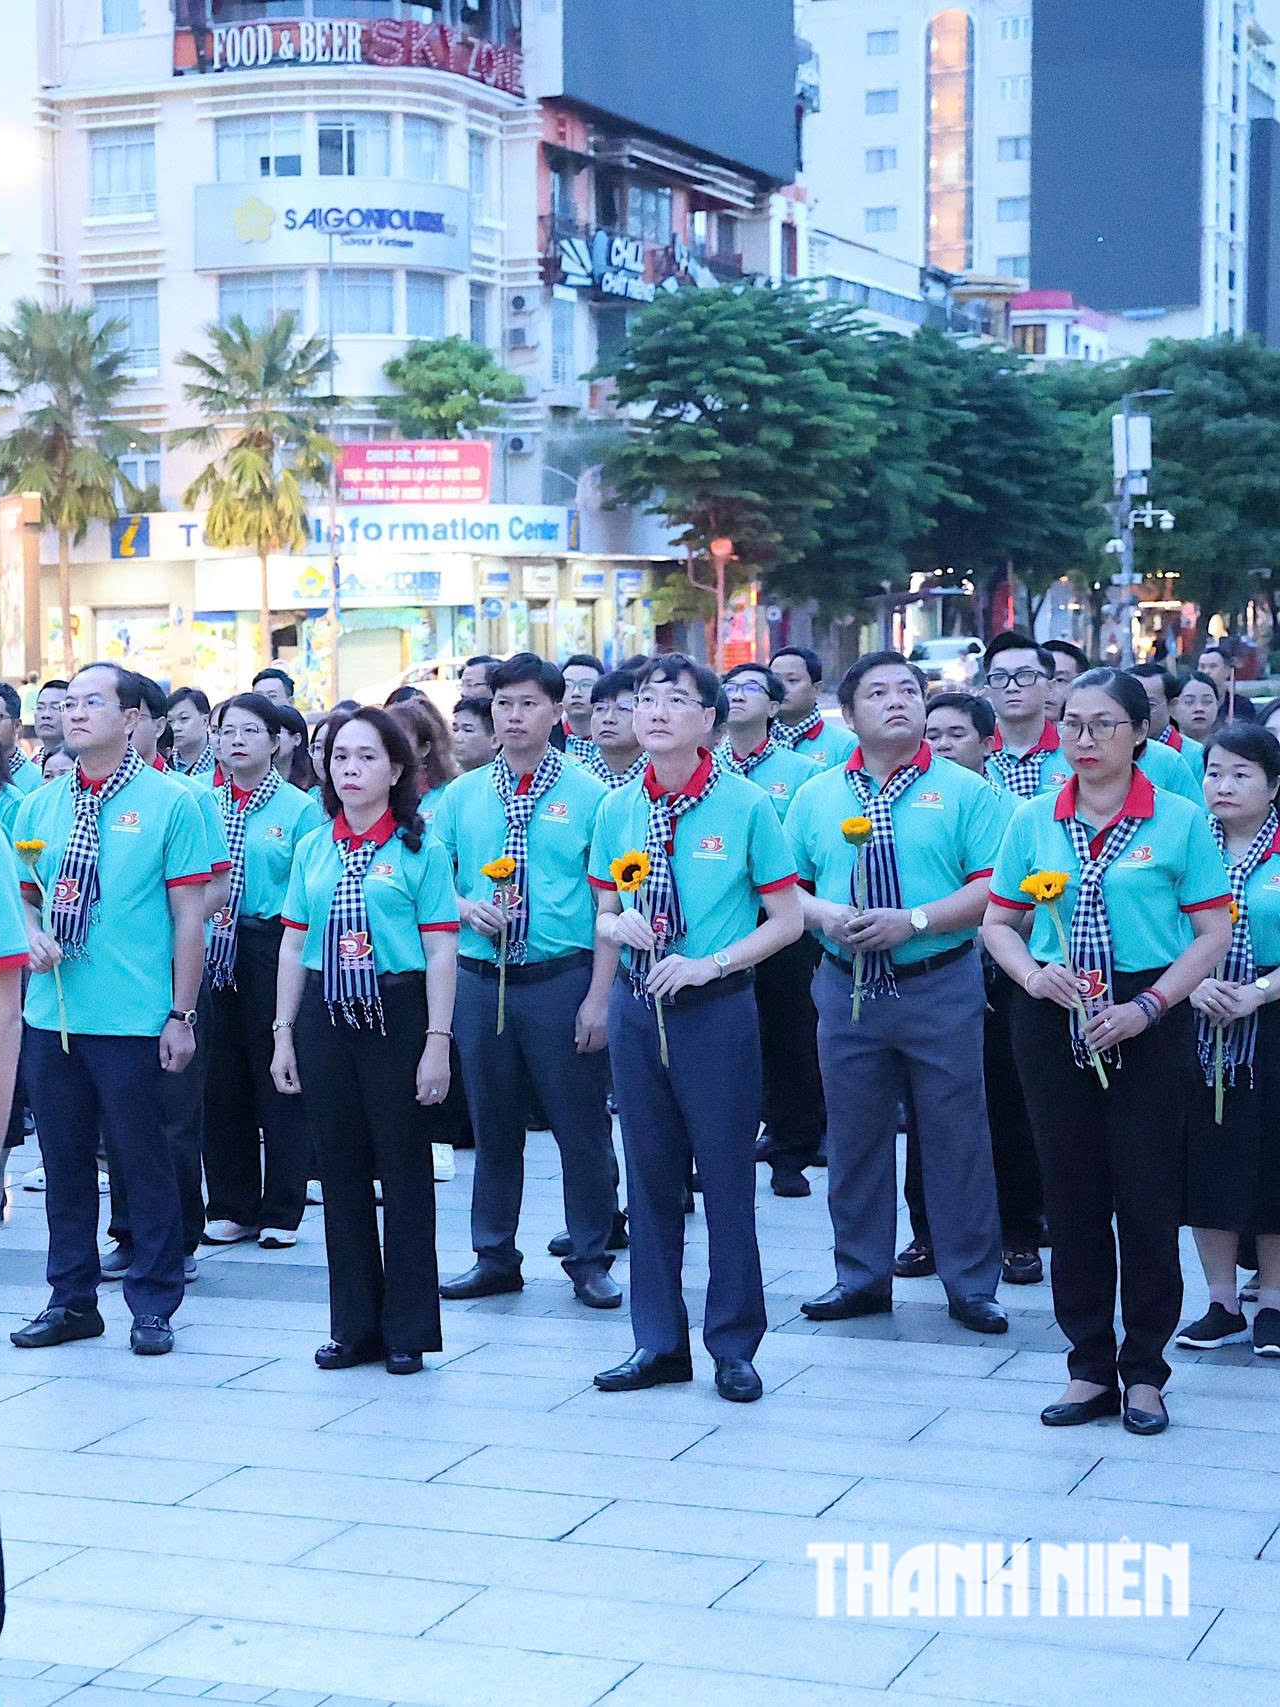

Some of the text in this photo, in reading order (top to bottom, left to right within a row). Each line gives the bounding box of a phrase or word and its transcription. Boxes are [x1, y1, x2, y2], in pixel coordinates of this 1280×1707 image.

[212, 21, 366, 69] FOOD & BEER
[314, 517, 500, 545] Information
[508, 516, 559, 541] Center
